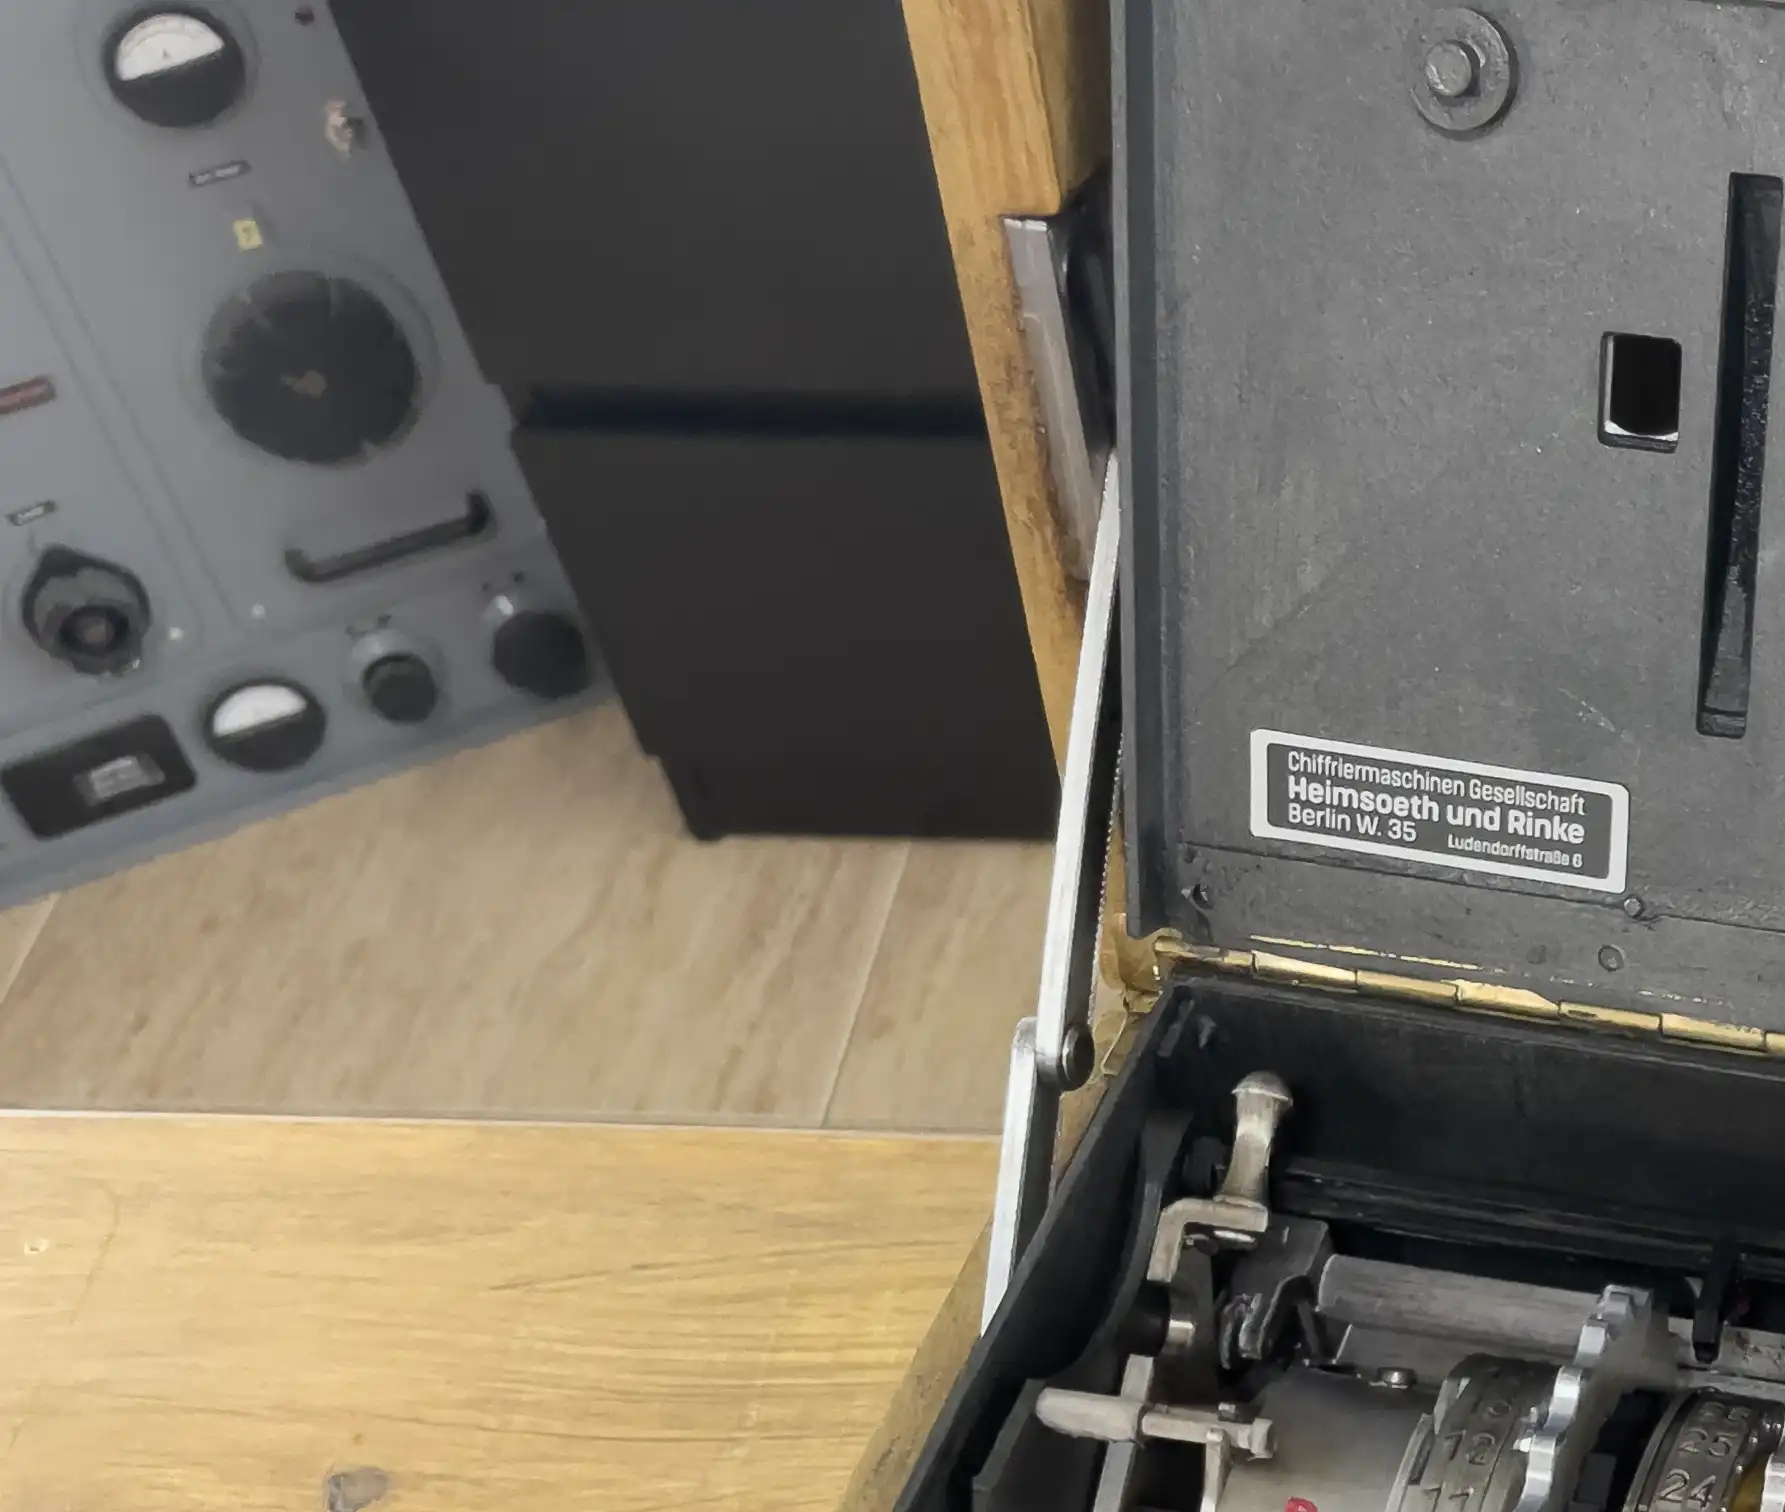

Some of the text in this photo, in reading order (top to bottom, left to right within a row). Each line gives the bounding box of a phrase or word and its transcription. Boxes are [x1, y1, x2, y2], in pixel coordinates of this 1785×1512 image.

[1287, 750, 1586, 817] Chiffriermaschinen Gesellschaft
[1287, 775, 1585, 845] Heimsoeth und Rinke
[1287, 802, 1418, 843] Berlin W. 35
[1659, 1468, 1718, 1512] 24
